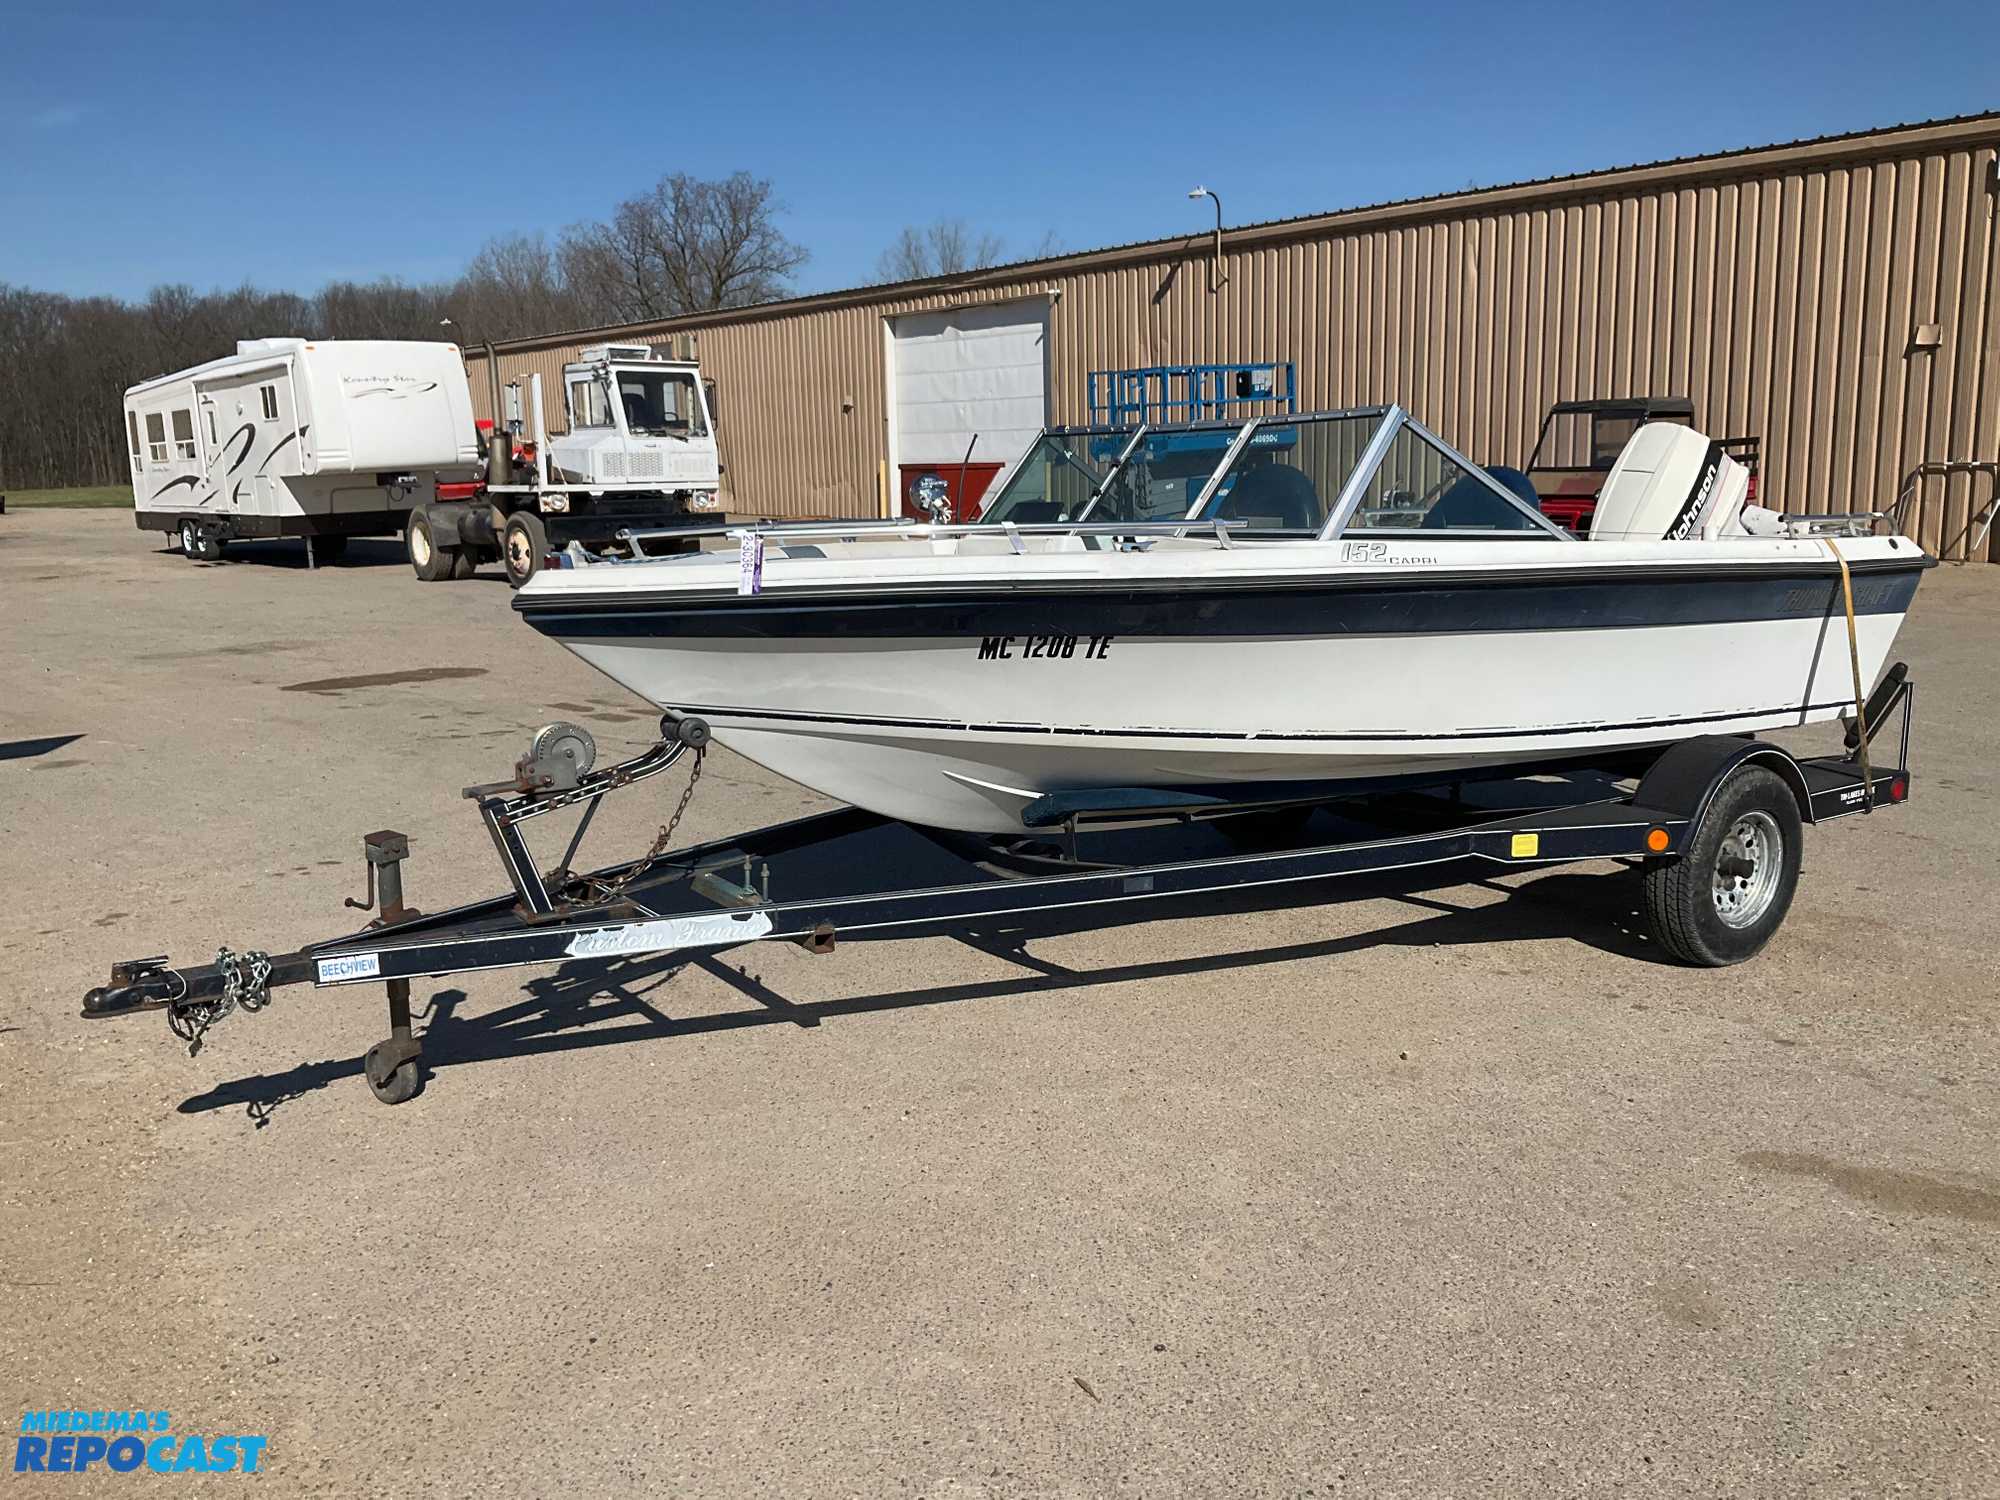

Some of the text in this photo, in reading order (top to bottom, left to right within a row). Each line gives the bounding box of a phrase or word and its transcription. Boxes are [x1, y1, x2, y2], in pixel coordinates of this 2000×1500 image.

[1666, 464, 1717, 540] Johnson
[742, 535, 754, 573] 2-30364
[1341, 542, 1387, 562] 152
[978, 635, 1114, 660] MC 1208 TE
[321, 959, 376, 976] BEECHVIEW
